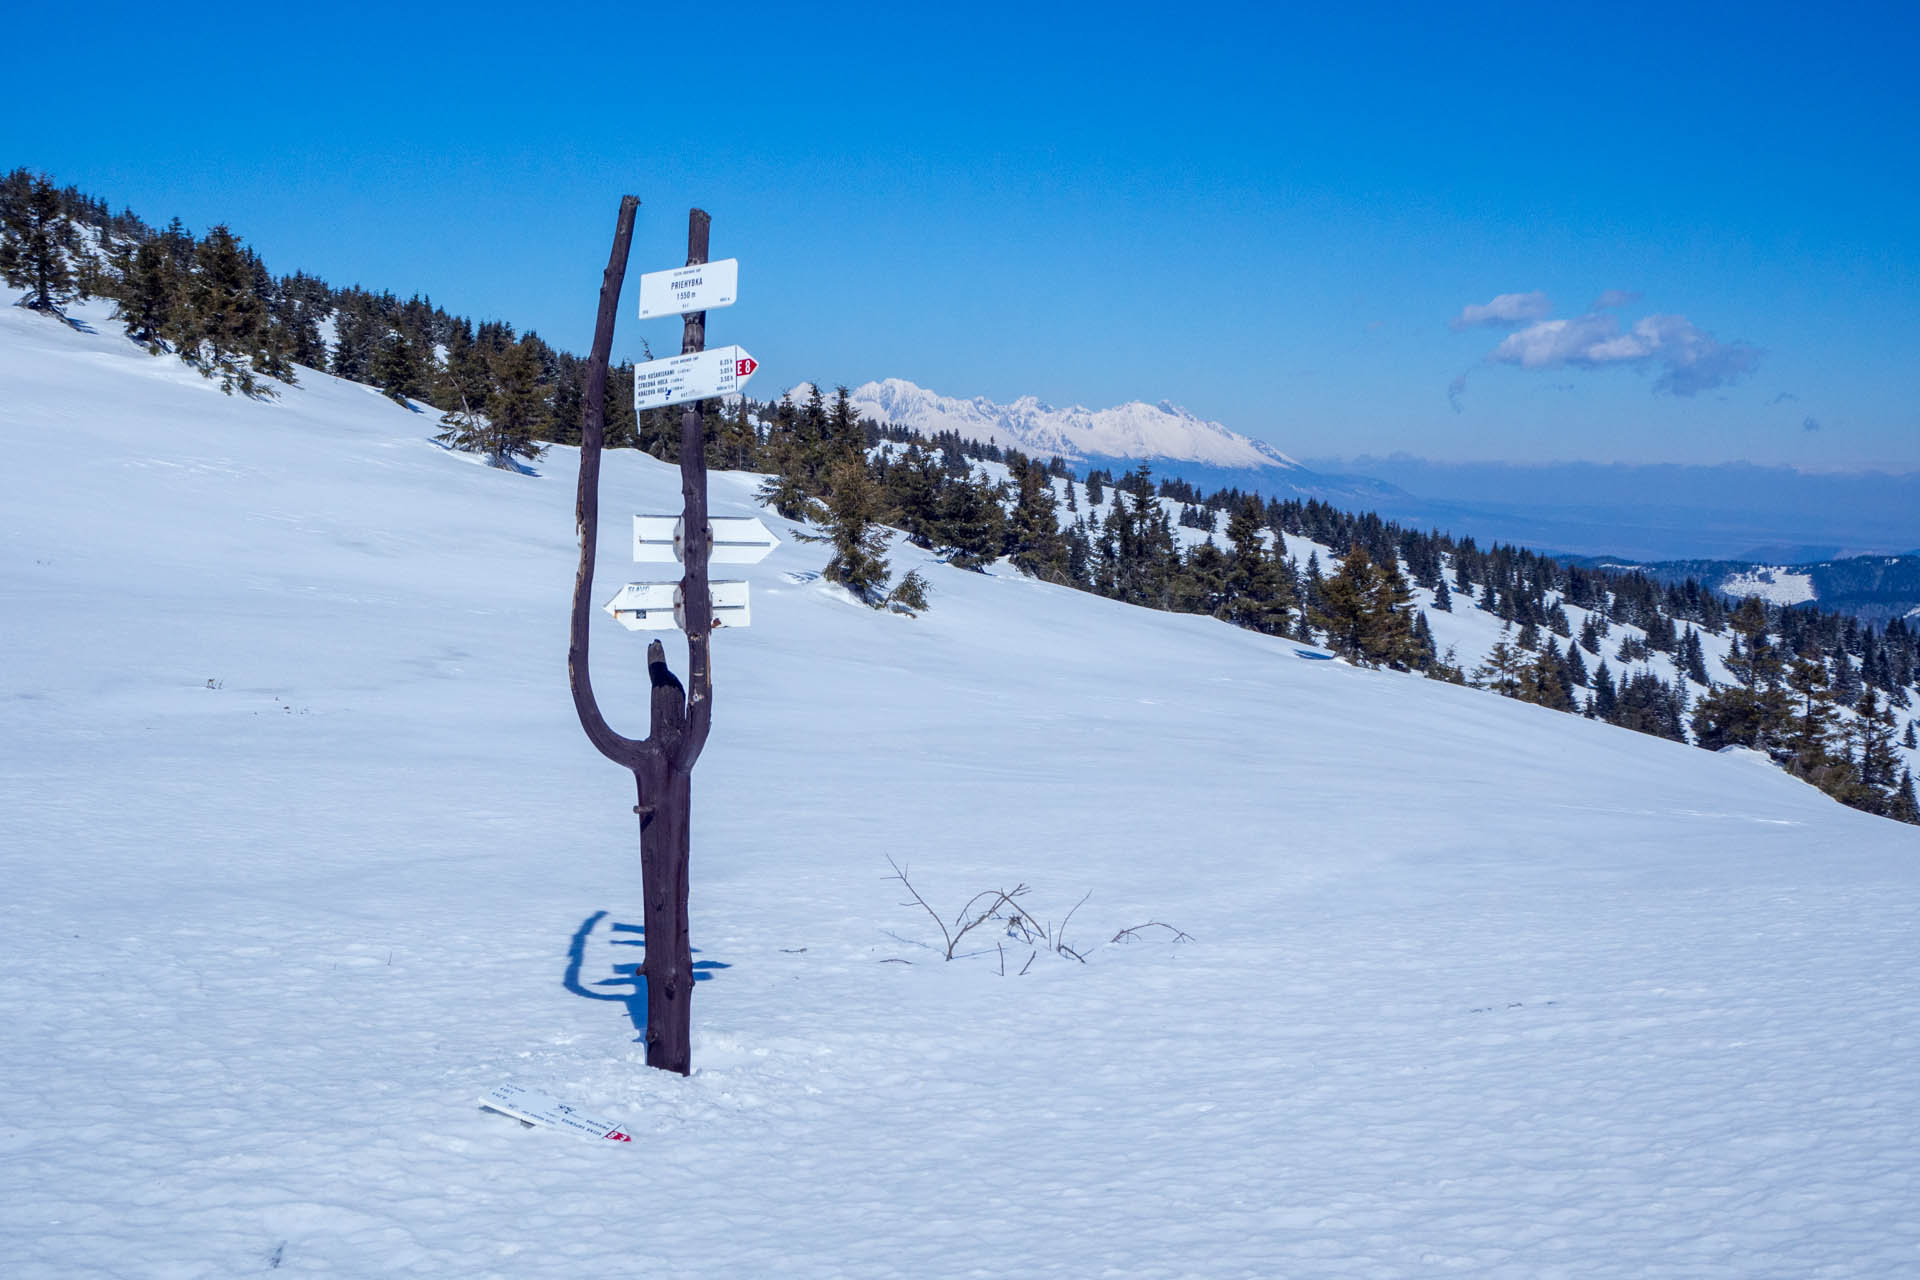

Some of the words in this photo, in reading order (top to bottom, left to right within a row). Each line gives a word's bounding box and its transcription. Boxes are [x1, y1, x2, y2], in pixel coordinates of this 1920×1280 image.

[671, 277, 703, 290] PRIEHYBKA
[737, 361, 743, 375] E
[745, 360, 751, 374] 8
